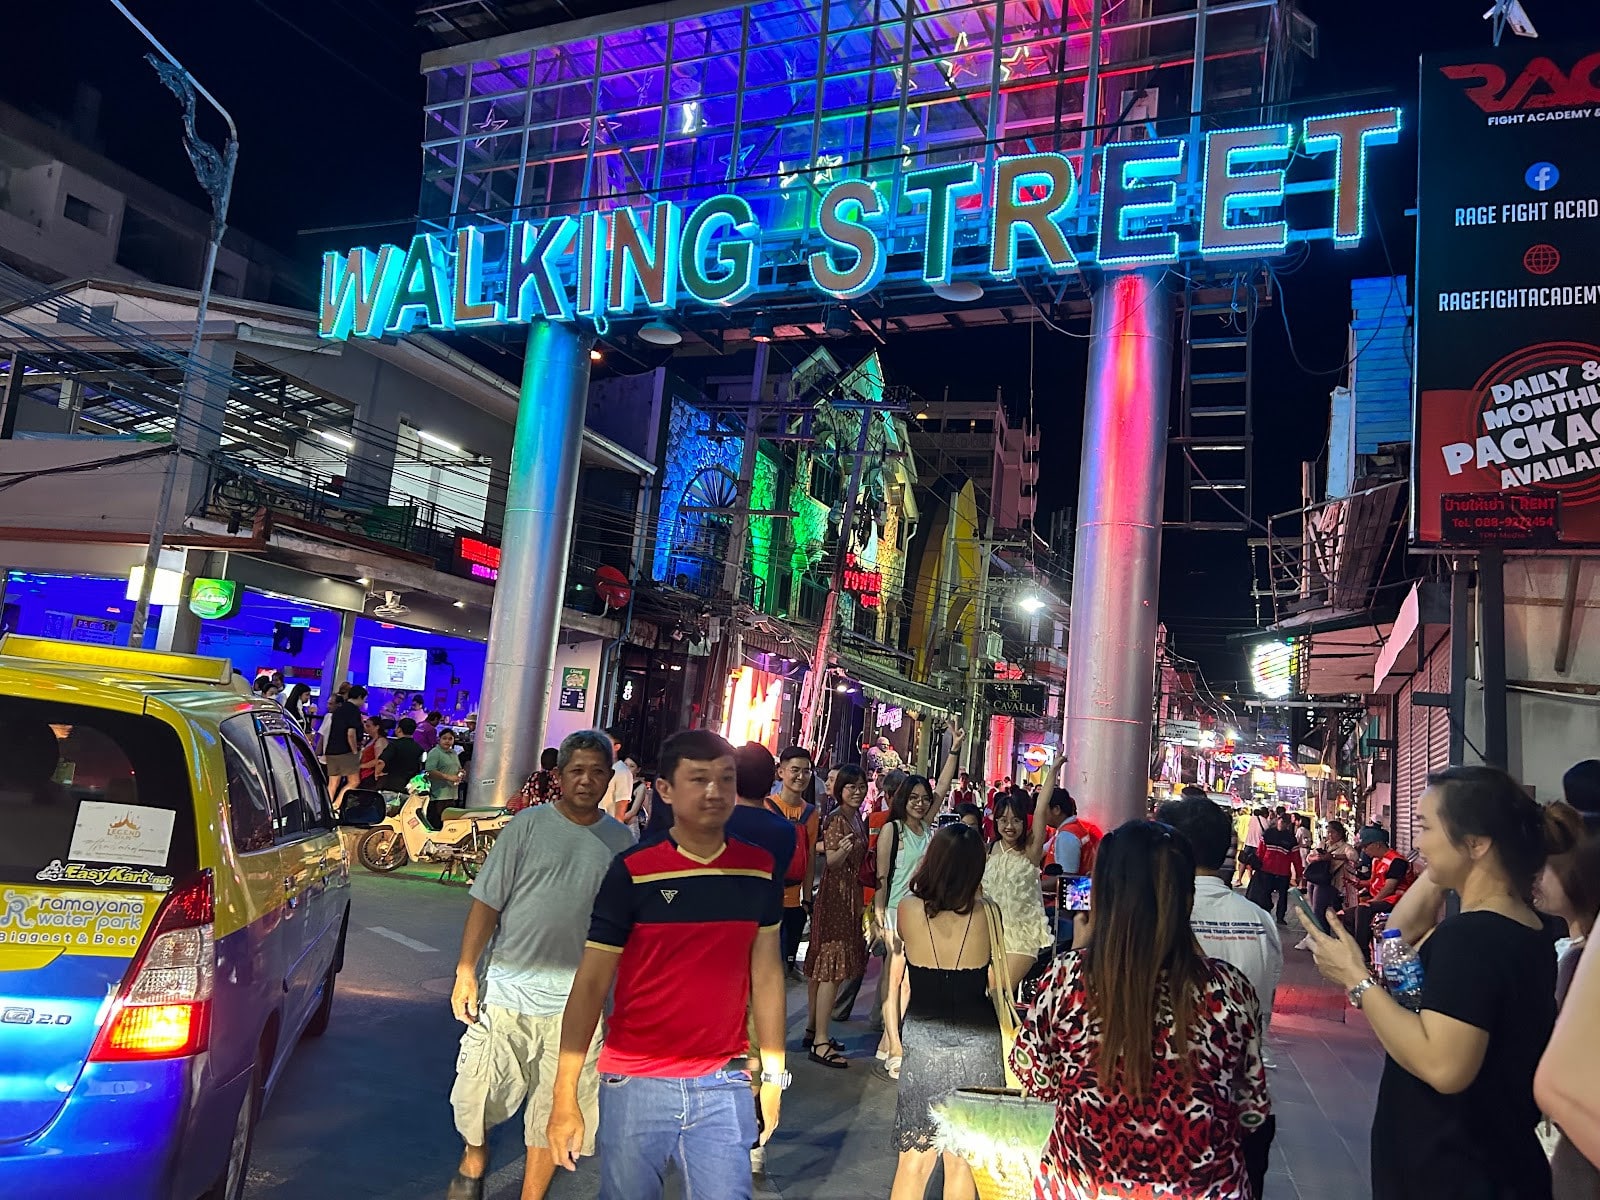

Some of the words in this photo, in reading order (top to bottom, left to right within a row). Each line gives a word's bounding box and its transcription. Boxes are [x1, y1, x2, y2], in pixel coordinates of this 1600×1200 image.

[1487, 114, 1525, 126] FIGHT
[1527, 108, 1592, 122] ACADEMY
[1455, 205, 1497, 226] RAGE
[1502, 201, 1549, 223] FIGHT
[1554, 199, 1599, 219] ACAD
[319, 194, 760, 341] WALKING
[808, 107, 1402, 298] STREET
[1491, 366, 1570, 405] DAILY
[1482, 383, 1600, 431] MONTHL
[993, 700, 1035, 712] CAVALLI
[107, 828, 141, 838] LEGEND
[39, 896, 144, 915] ramayana
[38, 911, 93, 927] water
[97, 914, 141, 931] park
[94, 934, 137, 945] Best
[36, 1014, 71, 1025] 2.0
